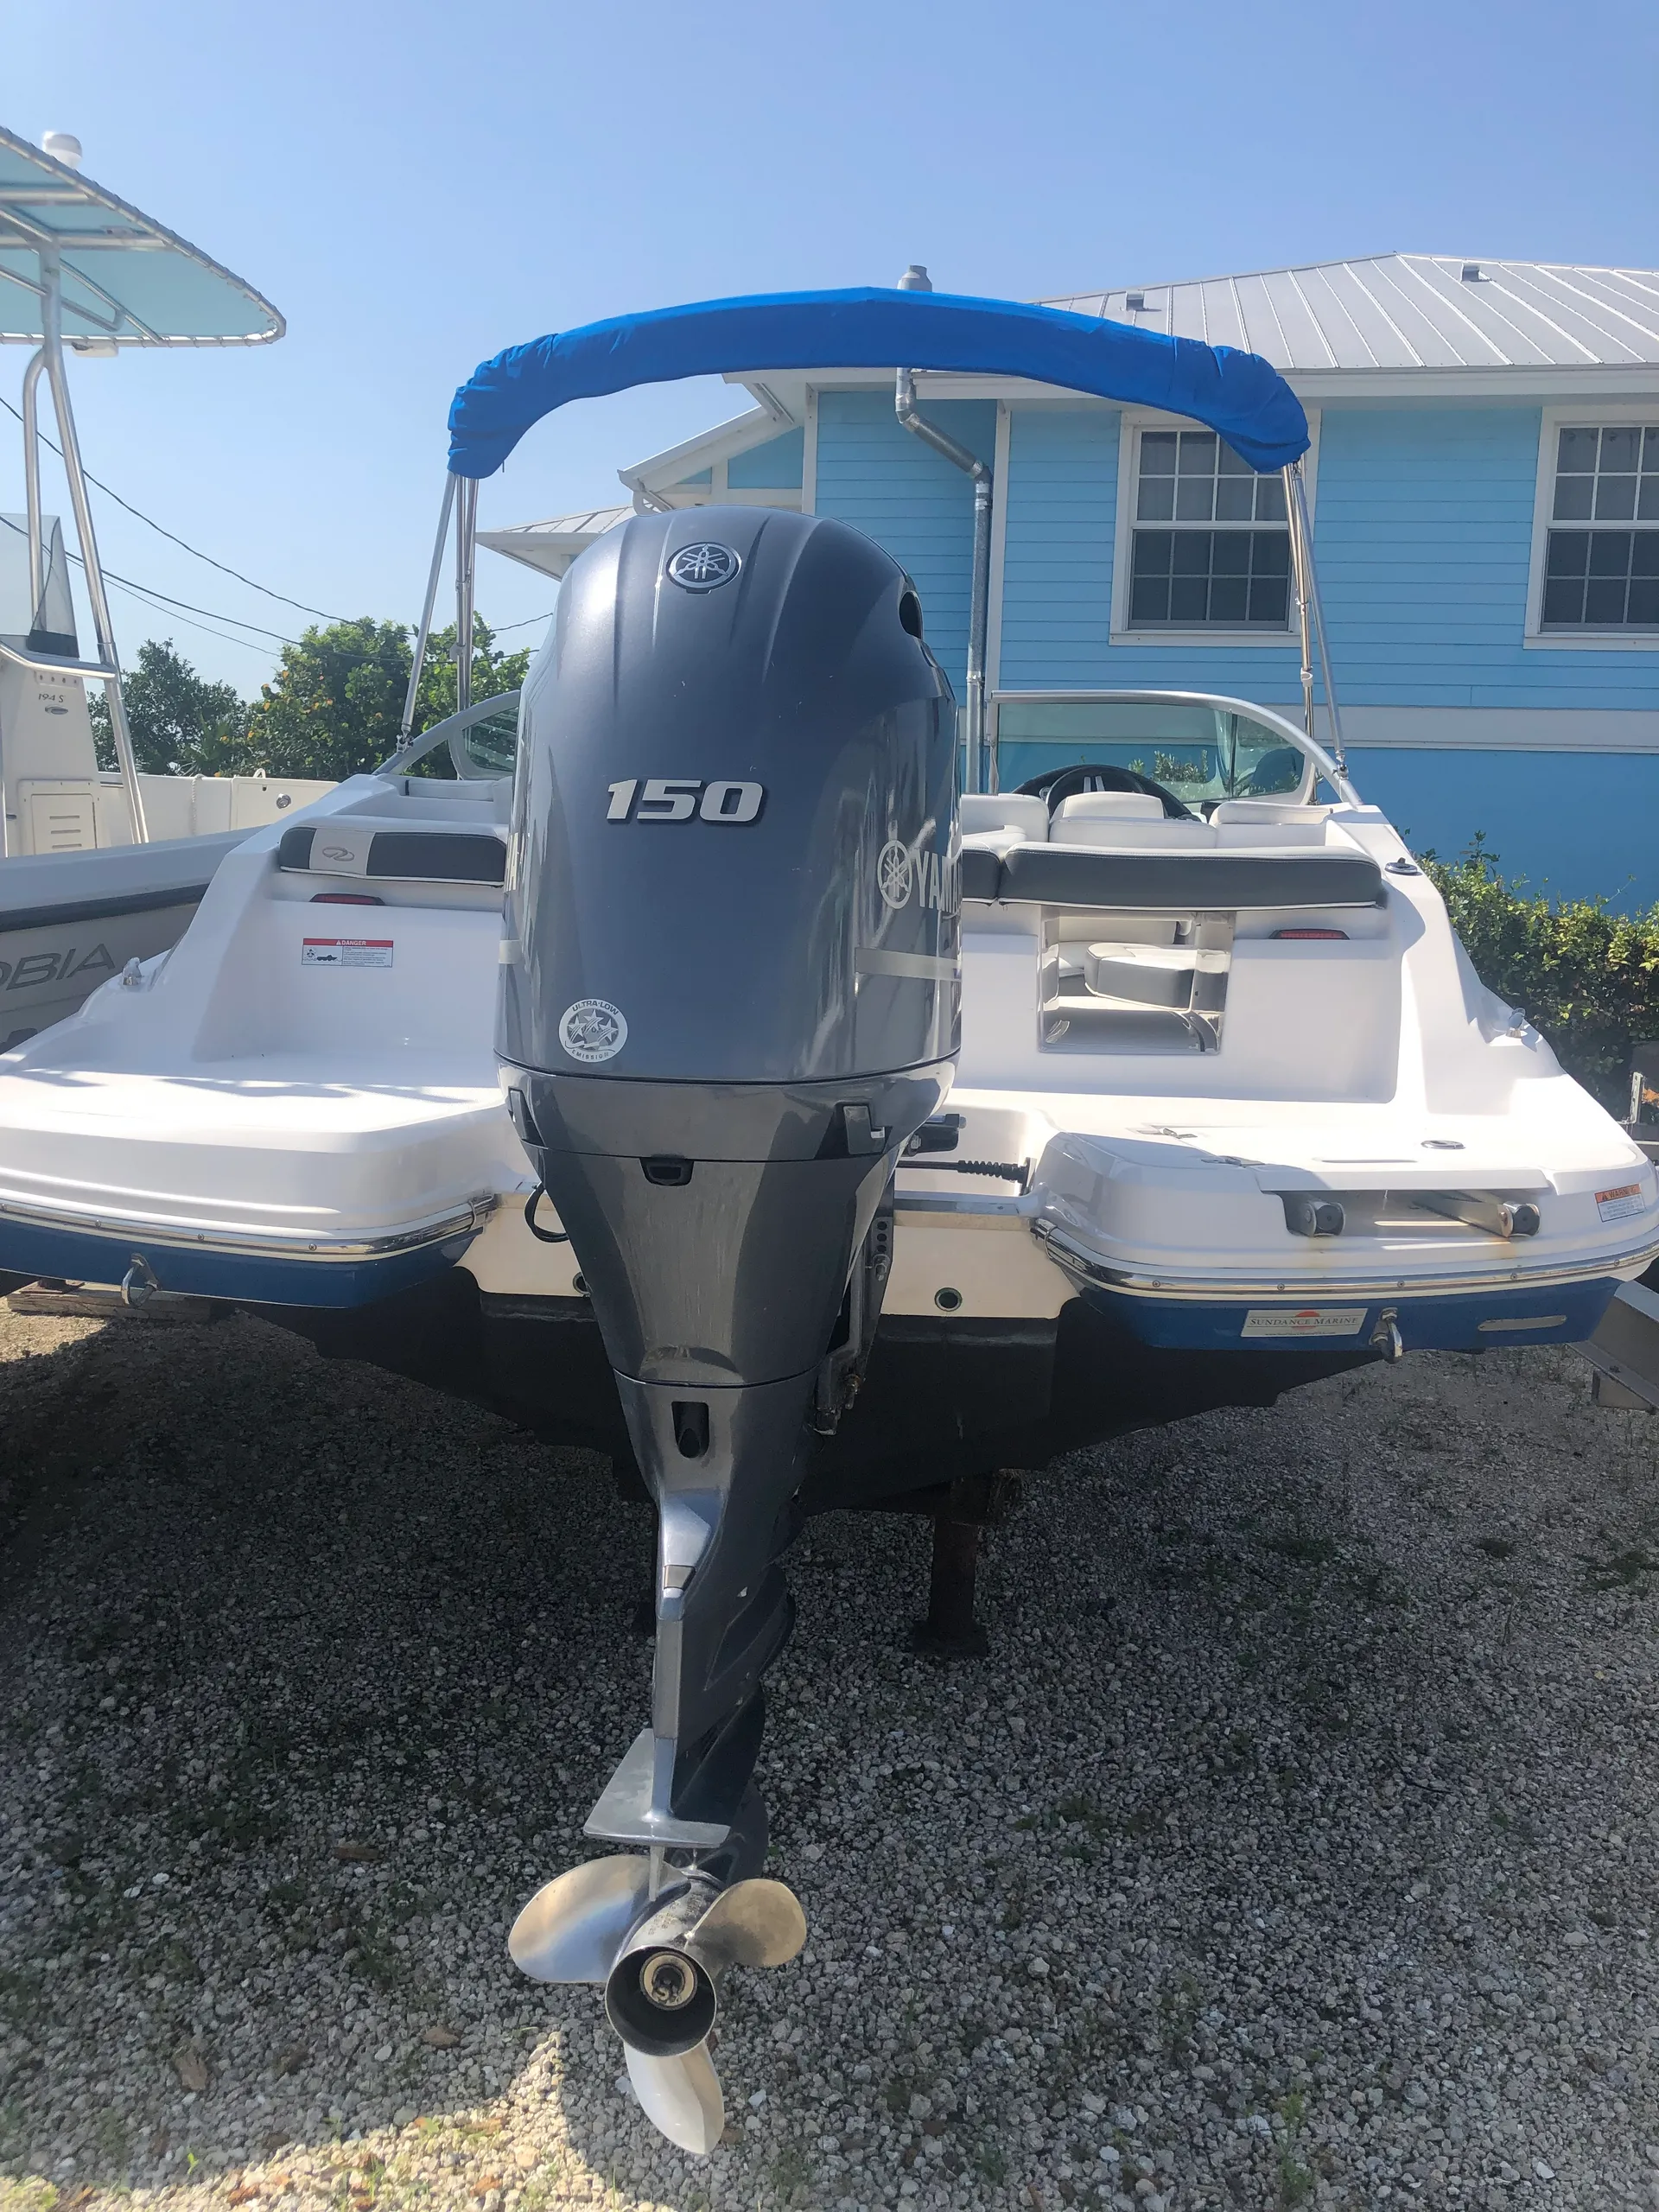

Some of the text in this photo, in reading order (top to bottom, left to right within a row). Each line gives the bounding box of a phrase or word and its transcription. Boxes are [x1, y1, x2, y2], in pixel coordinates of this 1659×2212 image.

[38, 693, 65, 703] 194 S
[606, 779, 764, 823] 150
